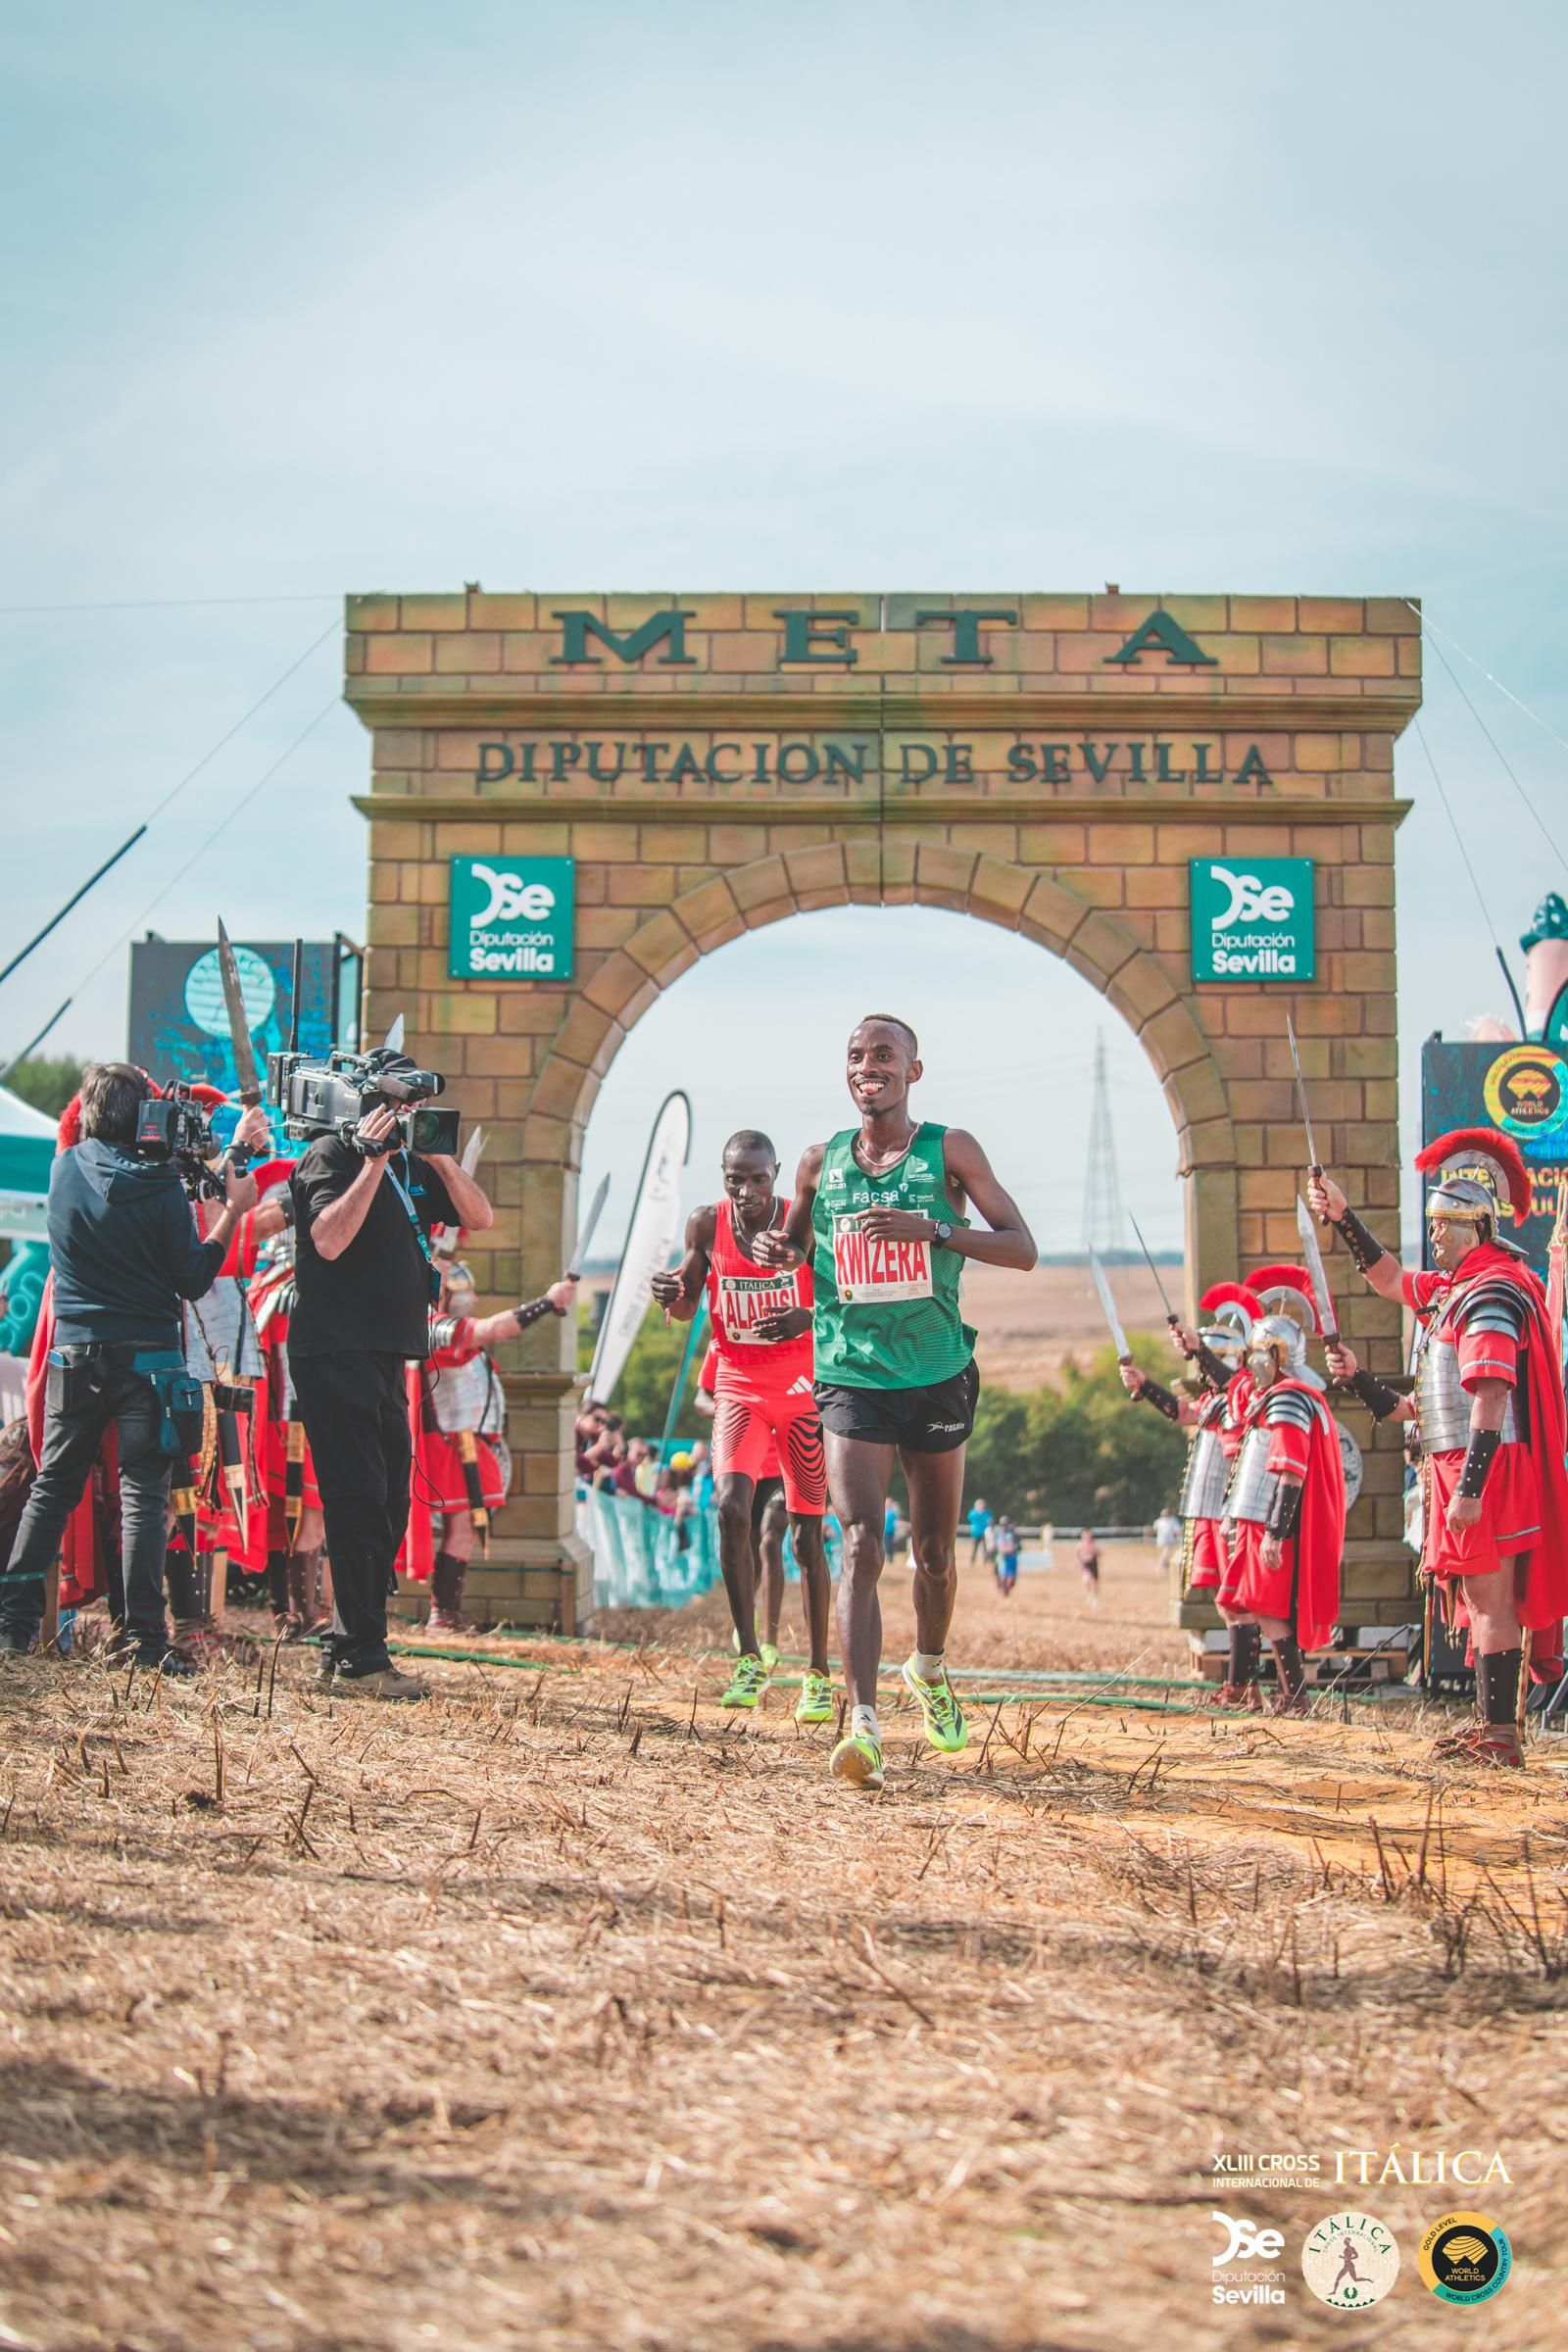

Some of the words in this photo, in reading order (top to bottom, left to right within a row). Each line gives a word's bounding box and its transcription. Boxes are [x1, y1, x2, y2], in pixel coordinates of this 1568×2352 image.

[549, 609, 1218, 664] META
[478, 741, 866, 785] DIPUTACION
[900, 743, 973, 785] DE
[1007, 742, 1273, 785] SEVILLA
[469, 930, 555, 949] Diputación
[1211, 932, 1295, 951] Diputación
[469, 947, 555, 972] Sevilla
[1212, 949, 1296, 973] Sevilla
[834, 1232, 928, 1286] KWIZERA
